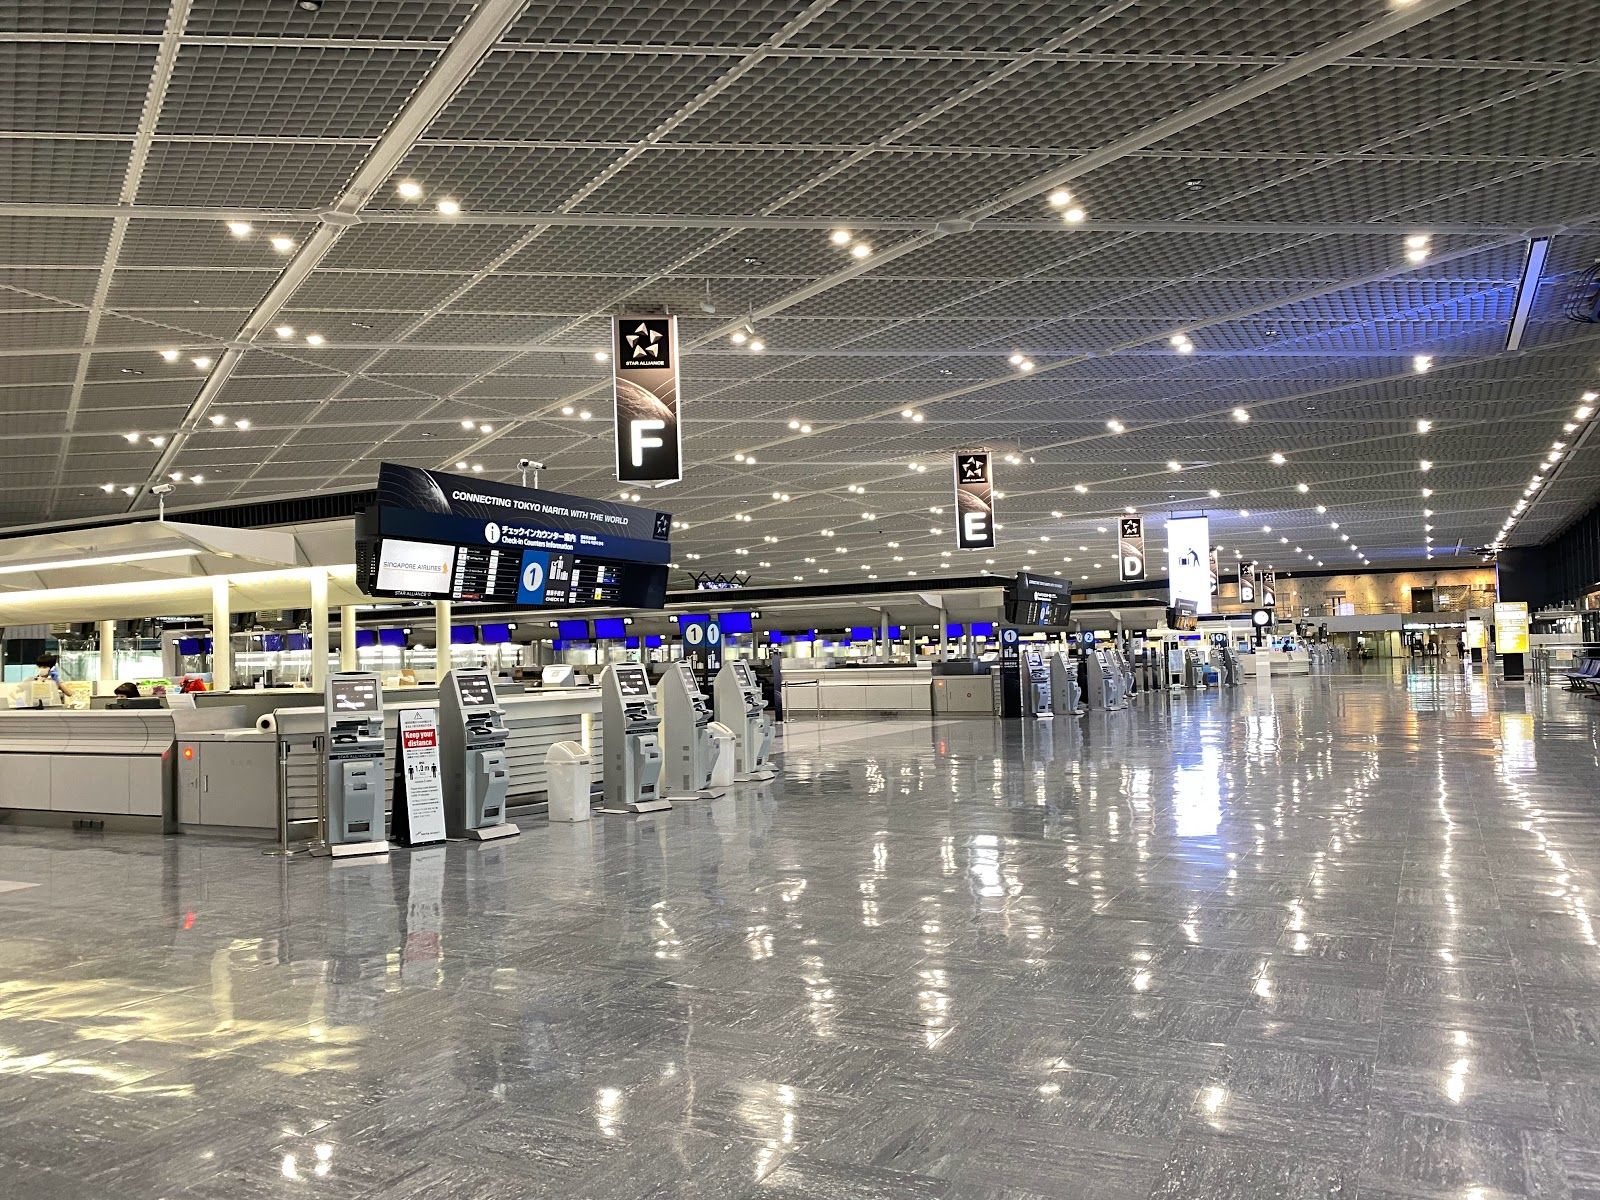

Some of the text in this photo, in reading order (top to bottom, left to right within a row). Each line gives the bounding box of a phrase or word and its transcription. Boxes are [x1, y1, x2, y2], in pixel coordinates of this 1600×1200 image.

[630, 420, 665, 466] F
[452, 490, 628, 525] CONNECTING TOKYO NARITA WITH THE WORLD
[964, 512, 988, 540] E
[502, 536, 524, 546] Check-in
[524, 538, 546, 548] Counters
[546, 541, 574, 550] Information
[383, 562, 416, 570] SINGAPORE
[1124, 556, 1142, 576] D
[530, 568, 536, 586] 1
[1242, 587, 1254, 600] B
[1264, 592, 1274, 604] A
